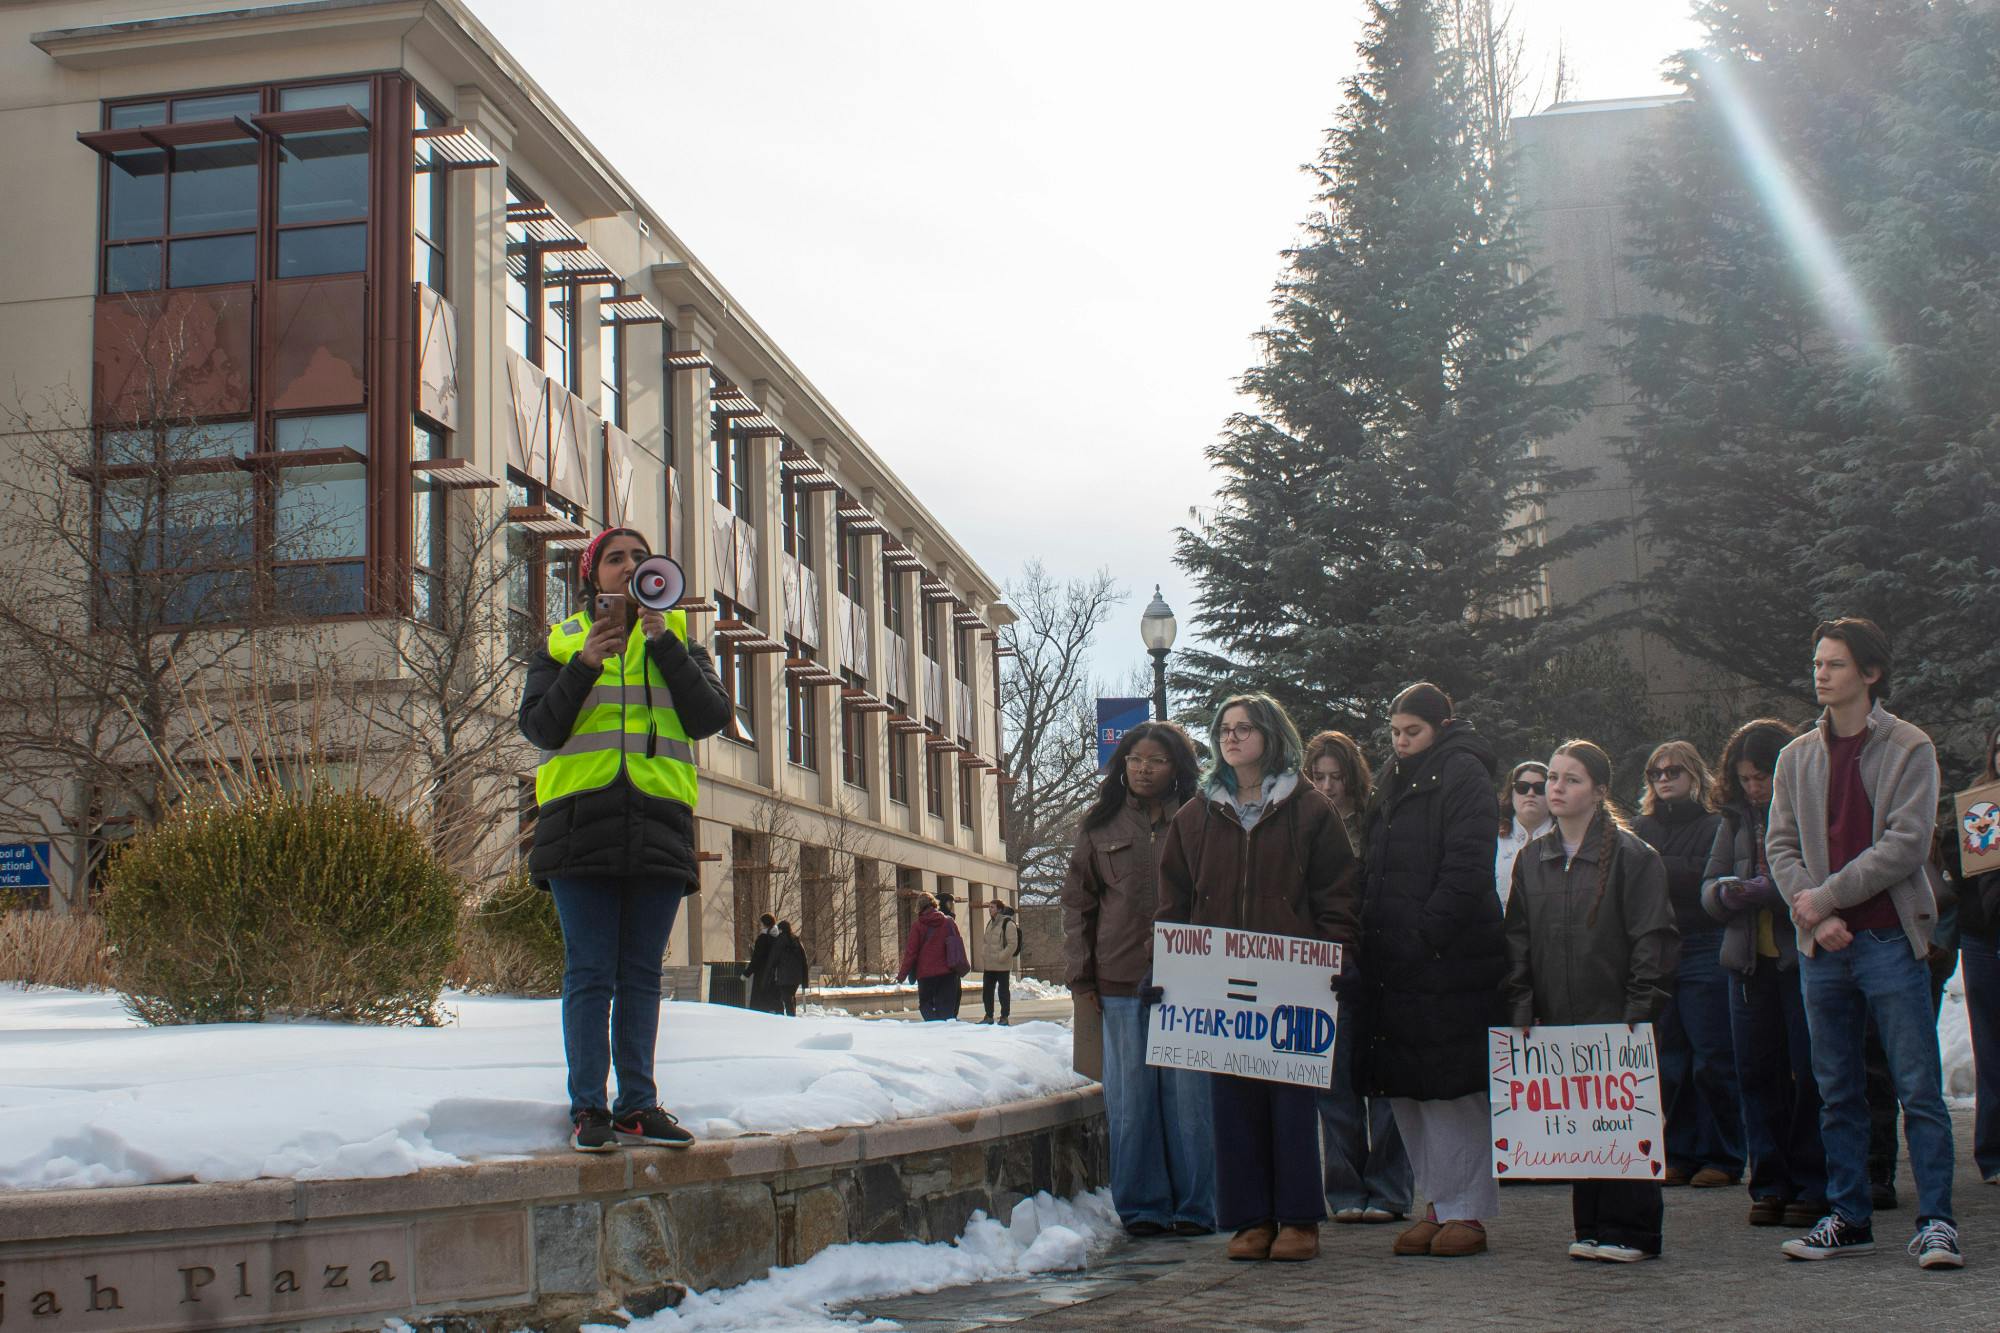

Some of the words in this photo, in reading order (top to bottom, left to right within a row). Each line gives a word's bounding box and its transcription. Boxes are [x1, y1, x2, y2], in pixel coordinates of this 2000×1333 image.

[15, 848, 25, 858] of
[1225, 932, 1284, 961] MEXICAN
[1158, 1004, 1268, 1040] 11-YEAR-OLD
[1270, 1004, 1335, 1054] CHILD
[1152, 1046, 1182, 1065] FIRE
[1186, 1048, 1217, 1069] EARL
[1224, 1052, 1279, 1076] ANTHONY
[1286, 1062, 1329, 1085] WAYNE
[1570, 1032, 1611, 1074] isn't
[1618, 1032, 1655, 1069] about
[1509, 1071, 1638, 1112] POLITICS
[1544, 1115, 1577, 1136] it's
[1592, 1114, 1634, 1132] about
[1508, 1139, 1650, 1174] humanity
[177, 1258, 396, 1305] Plaza
